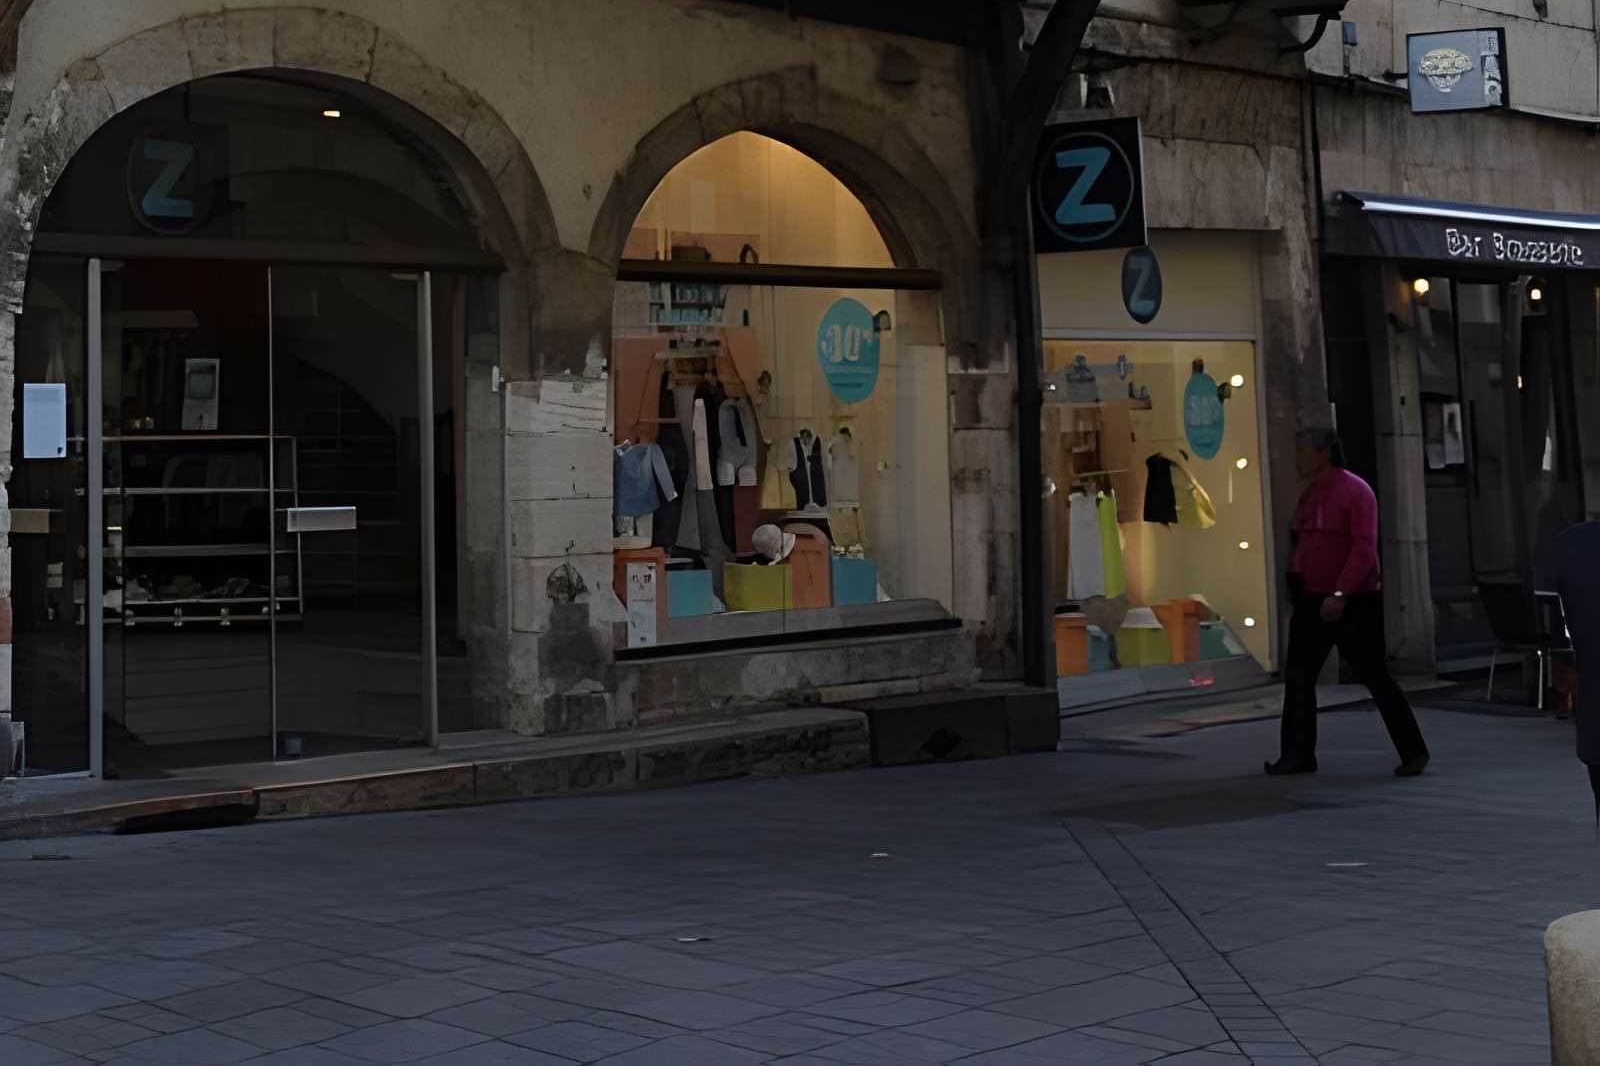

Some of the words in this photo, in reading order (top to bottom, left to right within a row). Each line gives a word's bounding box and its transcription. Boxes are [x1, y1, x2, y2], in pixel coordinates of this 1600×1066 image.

[142, 138, 193, 218] Z
[1055, 146, 1117, 225] Z
[1128, 254, 1156, 316] Z
